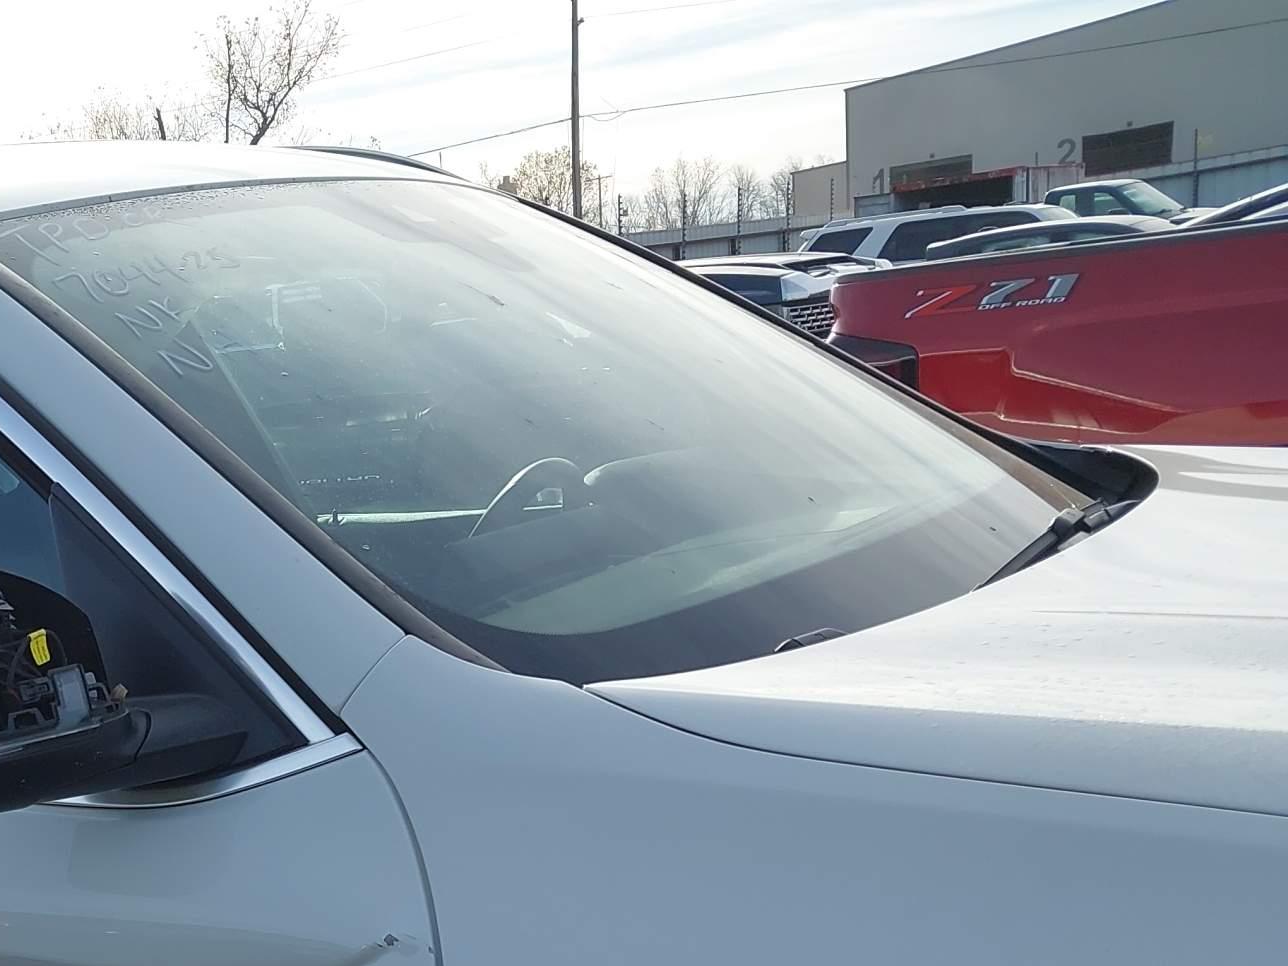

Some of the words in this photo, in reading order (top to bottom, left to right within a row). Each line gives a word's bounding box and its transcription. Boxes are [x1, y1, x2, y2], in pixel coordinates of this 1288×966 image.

[1057, 138, 1076, 164] 2
[872, 167, 885, 194] 1
[904, 273, 1080, 319] Z71
[977, 301, 1012, 311] OFF
[1015, 296, 1066, 308] ROAD
